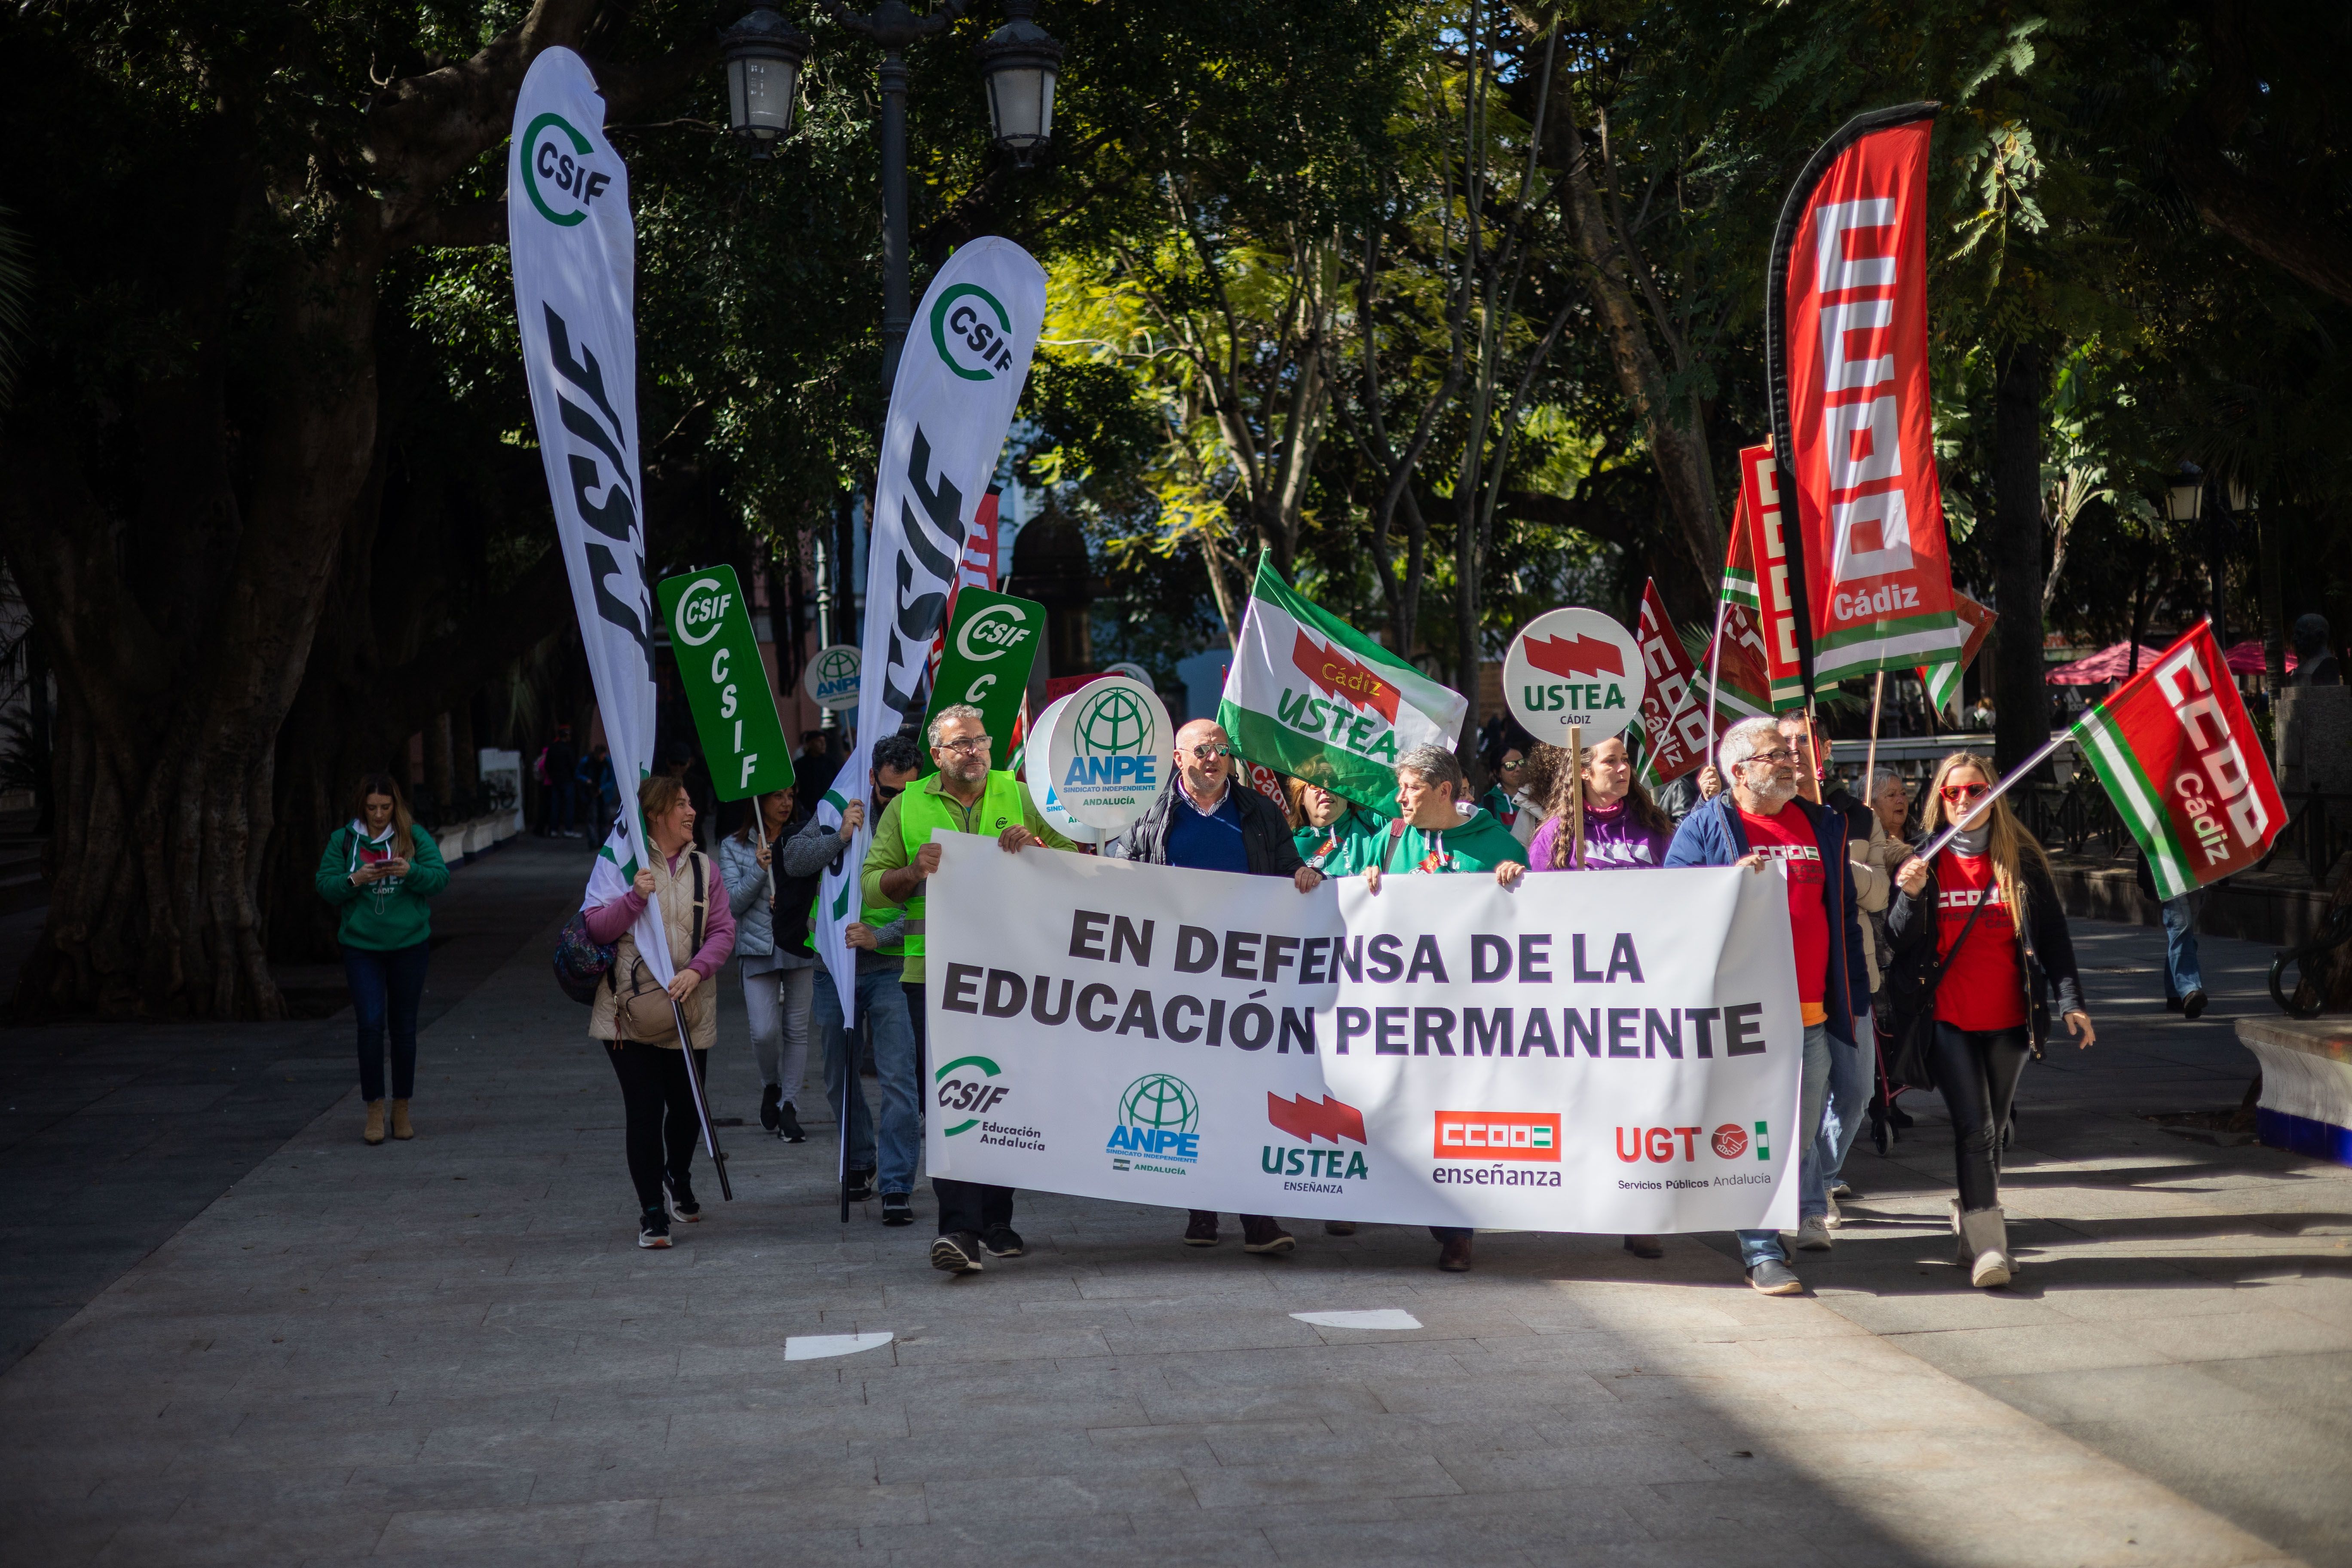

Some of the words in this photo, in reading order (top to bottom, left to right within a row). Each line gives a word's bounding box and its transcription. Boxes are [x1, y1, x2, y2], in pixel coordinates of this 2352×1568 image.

[537, 141, 611, 206] CSIF
[950, 306, 1013, 371] CSIF
[1816, 198, 1915, 587] CCOO
[542, 300, 655, 684] CSIF
[686, 594, 731, 625] CSIF
[1834, 584, 1920, 621] Cádiz
[972, 620, 1031, 647] CSIF
[1322, 663, 1383, 697] Cádiz
[1524, 683, 1626, 711] USTEA
[712, 648, 757, 789] CSIF
[1277, 688, 1399, 763] USTEA
[1560, 714, 1591, 725] CÁDIZ
[2155, 646, 2269, 848] CCOO
[1063, 755, 1157, 786] ANPE
[1083, 796, 1135, 806] ANDALUCÍA
[2175, 773, 2230, 866] Cádiz
[1069, 909, 1155, 968] EN
[1174, 925, 1450, 985] DEFENSA
[1471, 934, 1553, 983] DE
[1572, 933, 1645, 983] LA
[942, 962, 1315, 1055] EDUCACIÓN
[1336, 1002, 1767, 1059] PERMANENTE
[938, 1080, 1010, 1113] CSIF
[980, 1134, 1045, 1151] Andalucía
[982, 1121, 1041, 1138] Educación
[1107, 1125, 1200, 1158] ANPE
[1442, 1123, 1531, 1148] CCOO
[1616, 1127, 1702, 1164] UGT
[1106, 1148, 1142, 1158] SINDICATO
[1144, 1153, 1197, 1164] INDEPENDIENTE
[1134, 1164, 1186, 1175] ANDALUCÍA
[1262, 1146, 1369, 1180] USTEA
[1284, 1181, 1343, 1194] ENSEÑANZA
[1433, 1163, 1562, 1188] enseñanza
[1618, 1180, 1662, 1189] Servicios
[1666, 1179, 1709, 1189] Públicos
[1713, 1173, 1771, 1187] Andalucía
